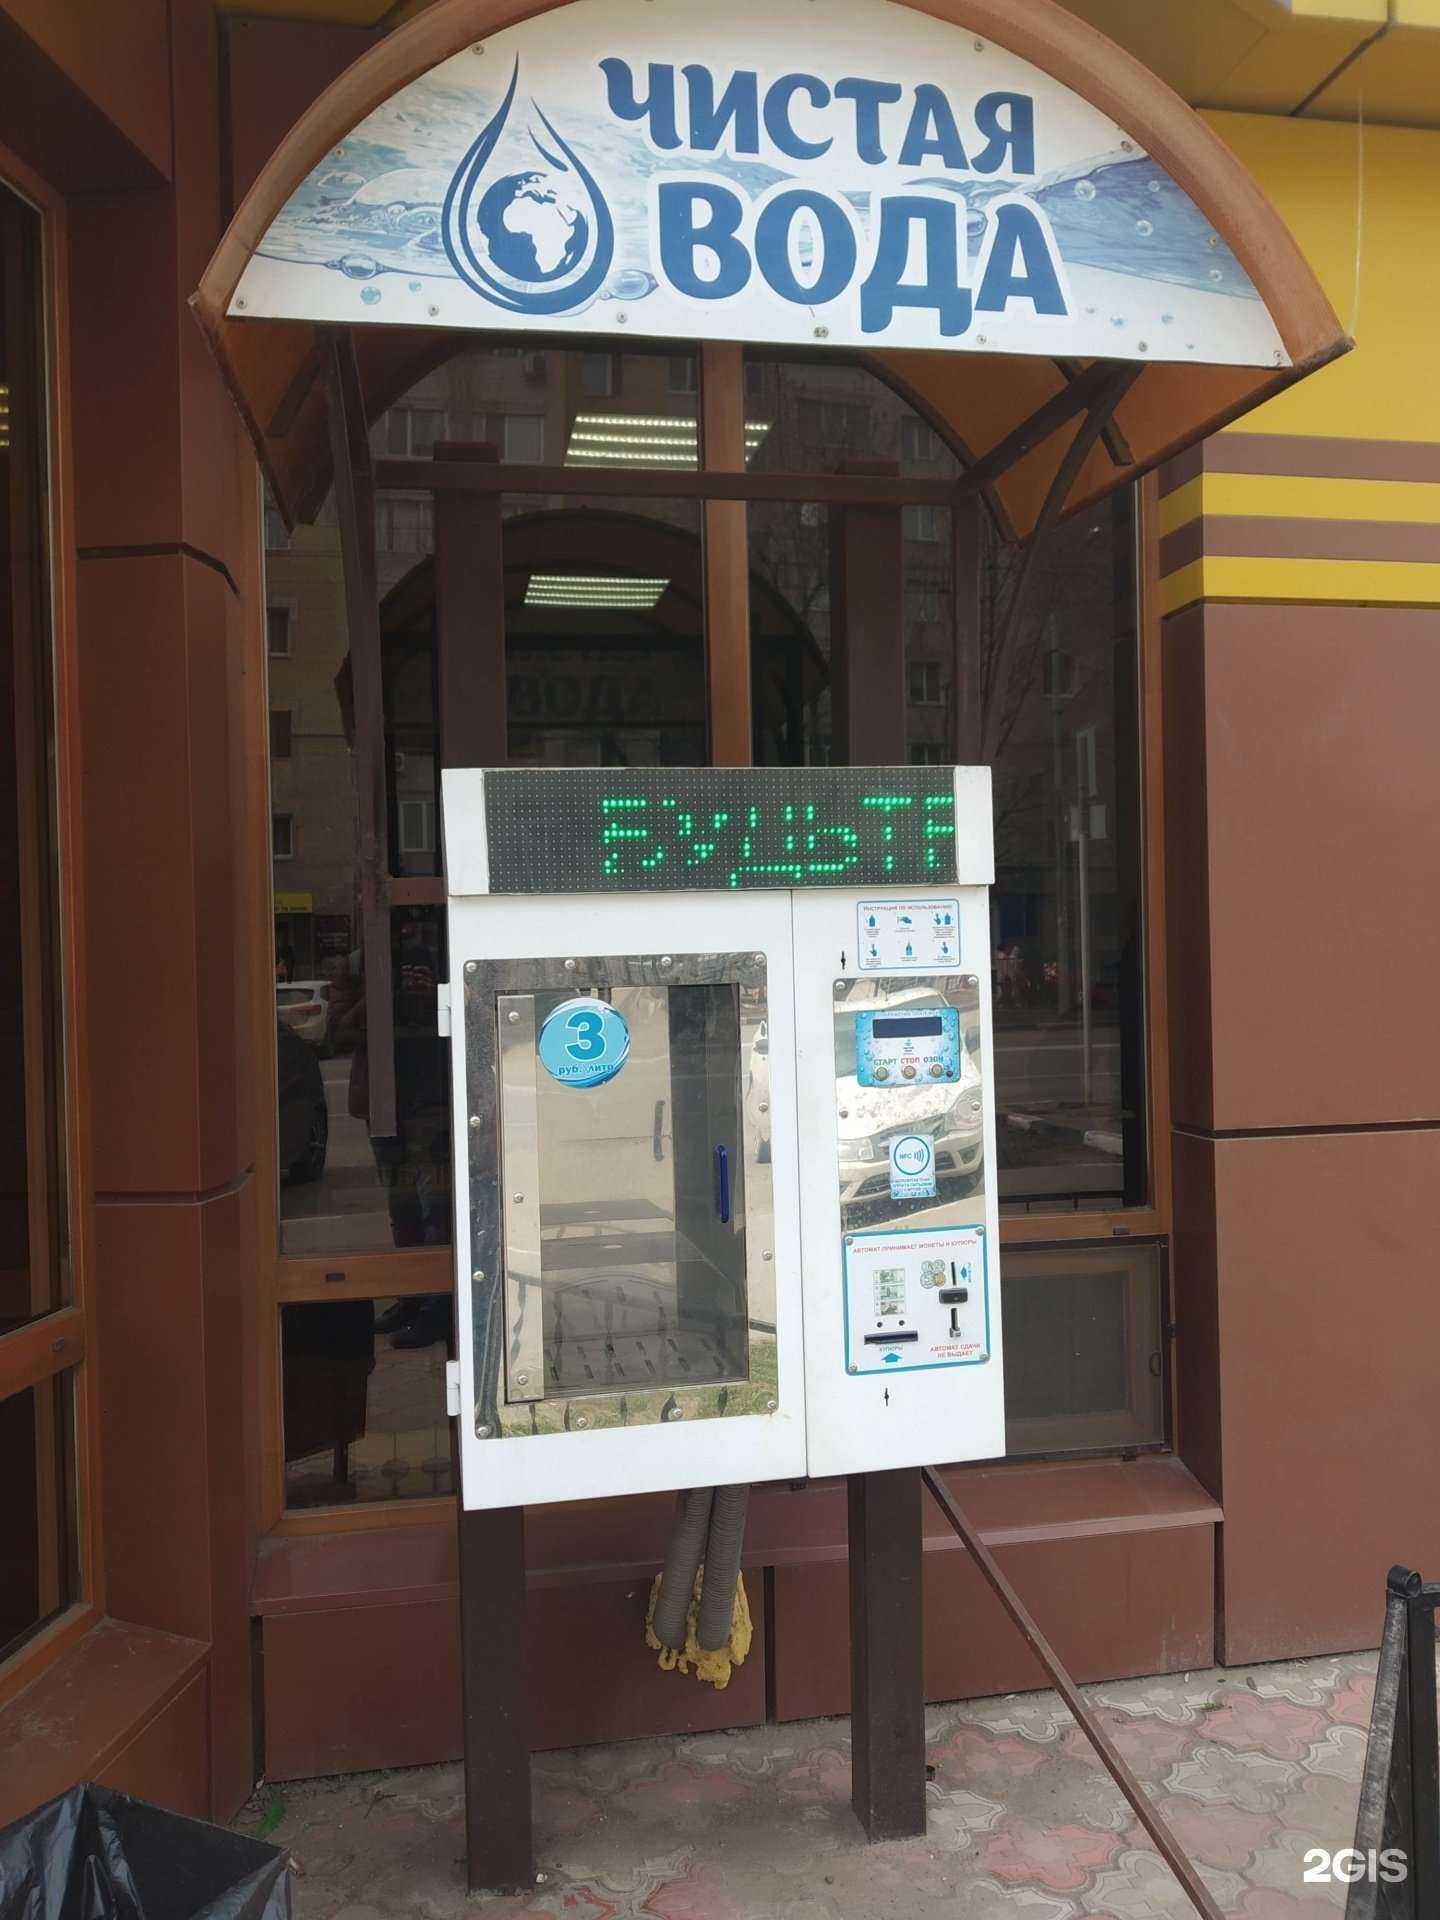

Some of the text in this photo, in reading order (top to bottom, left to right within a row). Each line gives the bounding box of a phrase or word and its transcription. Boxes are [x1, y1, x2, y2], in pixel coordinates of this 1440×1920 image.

[598, 57, 1034, 176] ЧИСТАЯ
[658, 182, 1068, 337] ВОДА
[565, 1010, 607, 1062] 3
[873, 1058, 897, 1066] СТАРТ
[923, 1055, 944, 1063] ОЗОН
[853, 1246, 881, 1254] АВТОМАТ
[918, 1241, 945, 1249] МОНЕТЫ
